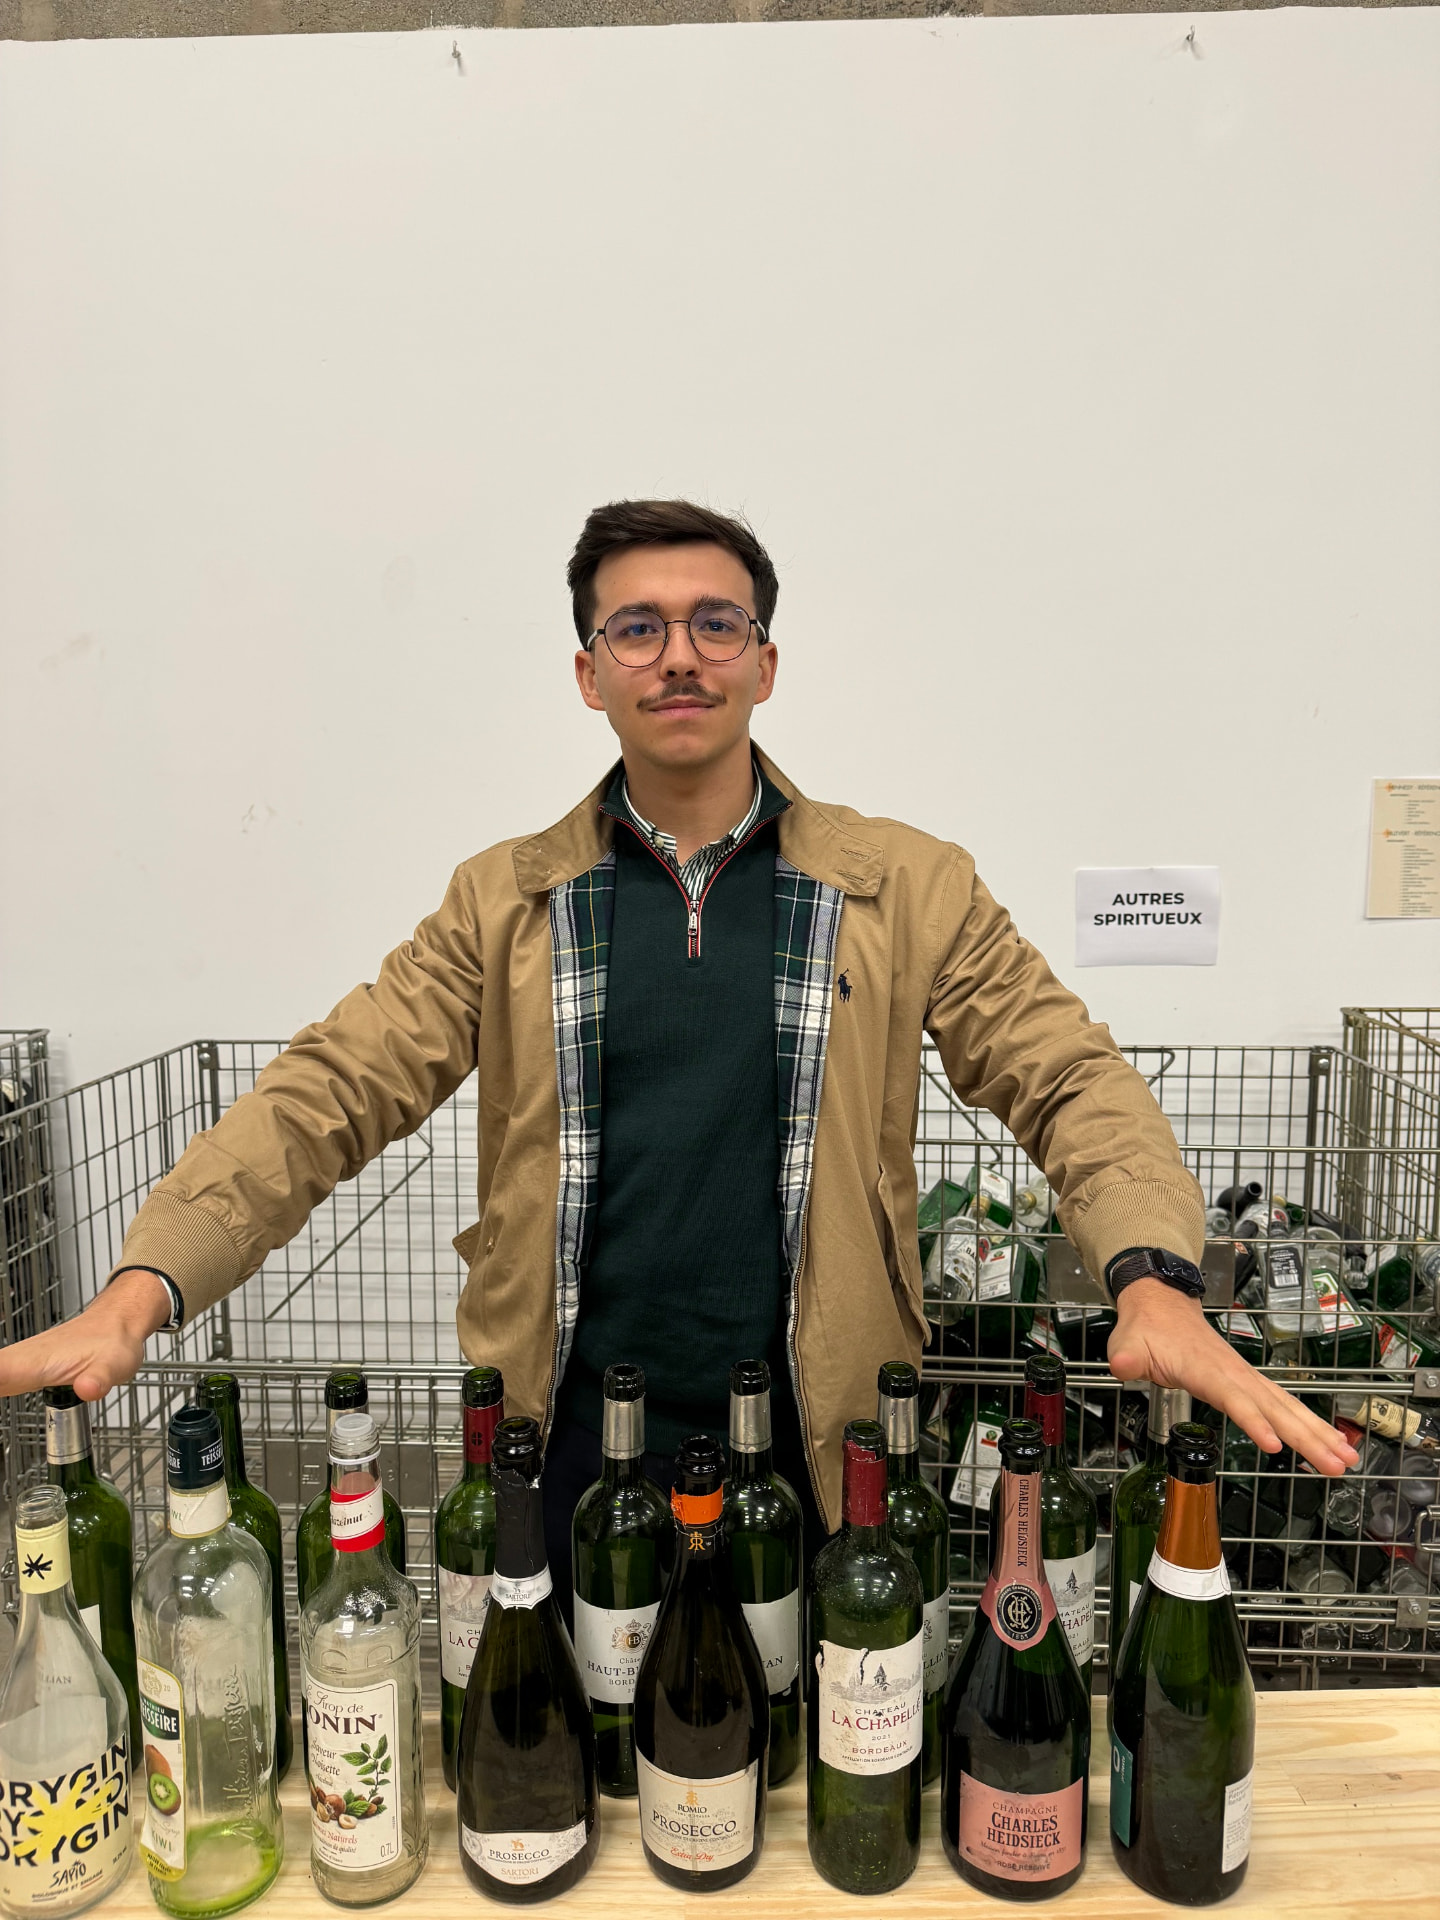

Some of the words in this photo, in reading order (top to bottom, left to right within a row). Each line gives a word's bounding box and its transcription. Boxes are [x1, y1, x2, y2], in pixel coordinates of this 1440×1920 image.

[1112, 893, 1185, 906] AUTRES
[1093, 912, 1202, 926] SPIRITUEUX
[1017, 1478, 1029, 1519] CHARLES
[1017, 1520, 1028, 1567] HEIDSIECK
[347, 1703, 364, 1714] de
[855, 1702, 906, 1715] CHATEAU
[140, 1700, 177, 1733] EISSEIRE
[832, 1709, 852, 1729] LA
[852, 1740, 907, 1755] BORDEAUX
[0, 1733, 126, 1808] RYGIN
[677, 1803, 708, 1814] ROMIO
[992, 1801, 1058, 1815] CHAMPAGNE
[653, 1810, 737, 1837] PROSECCO
[991, 1811, 1058, 1833] CHARLES
[987, 1826, 1061, 1848] HEIDSIECK
[489, 1849, 550, 1861] PROSECCO
[695, 1852, 714, 1862] Dry
[501, 1867, 539, 1876] SARTORI
